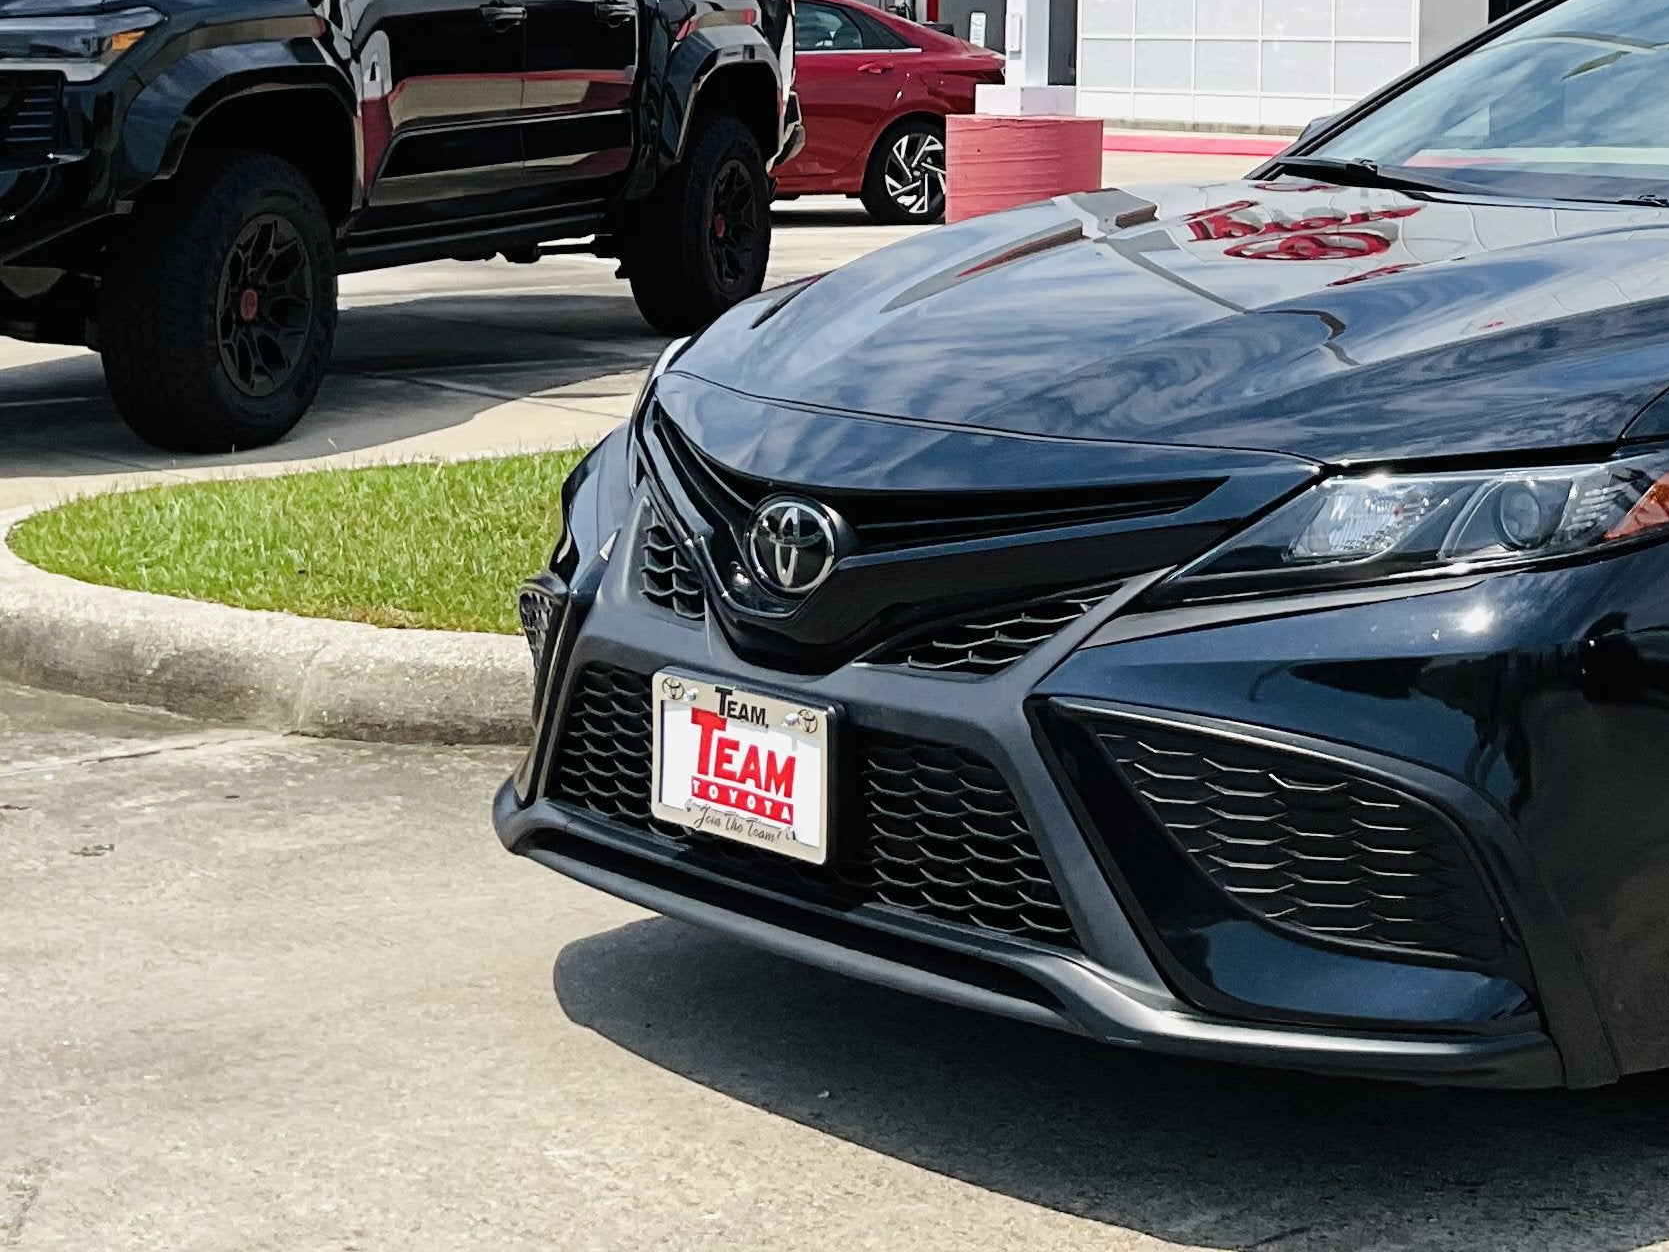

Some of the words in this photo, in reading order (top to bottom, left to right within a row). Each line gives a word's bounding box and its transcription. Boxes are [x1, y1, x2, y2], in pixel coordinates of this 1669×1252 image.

[691, 707, 796, 799] TEAM
[693, 779, 791, 821] TOYOTA
[693, 806, 721, 829] Join
[724, 813, 744, 833] The
[746, 817, 782, 842] Team!
